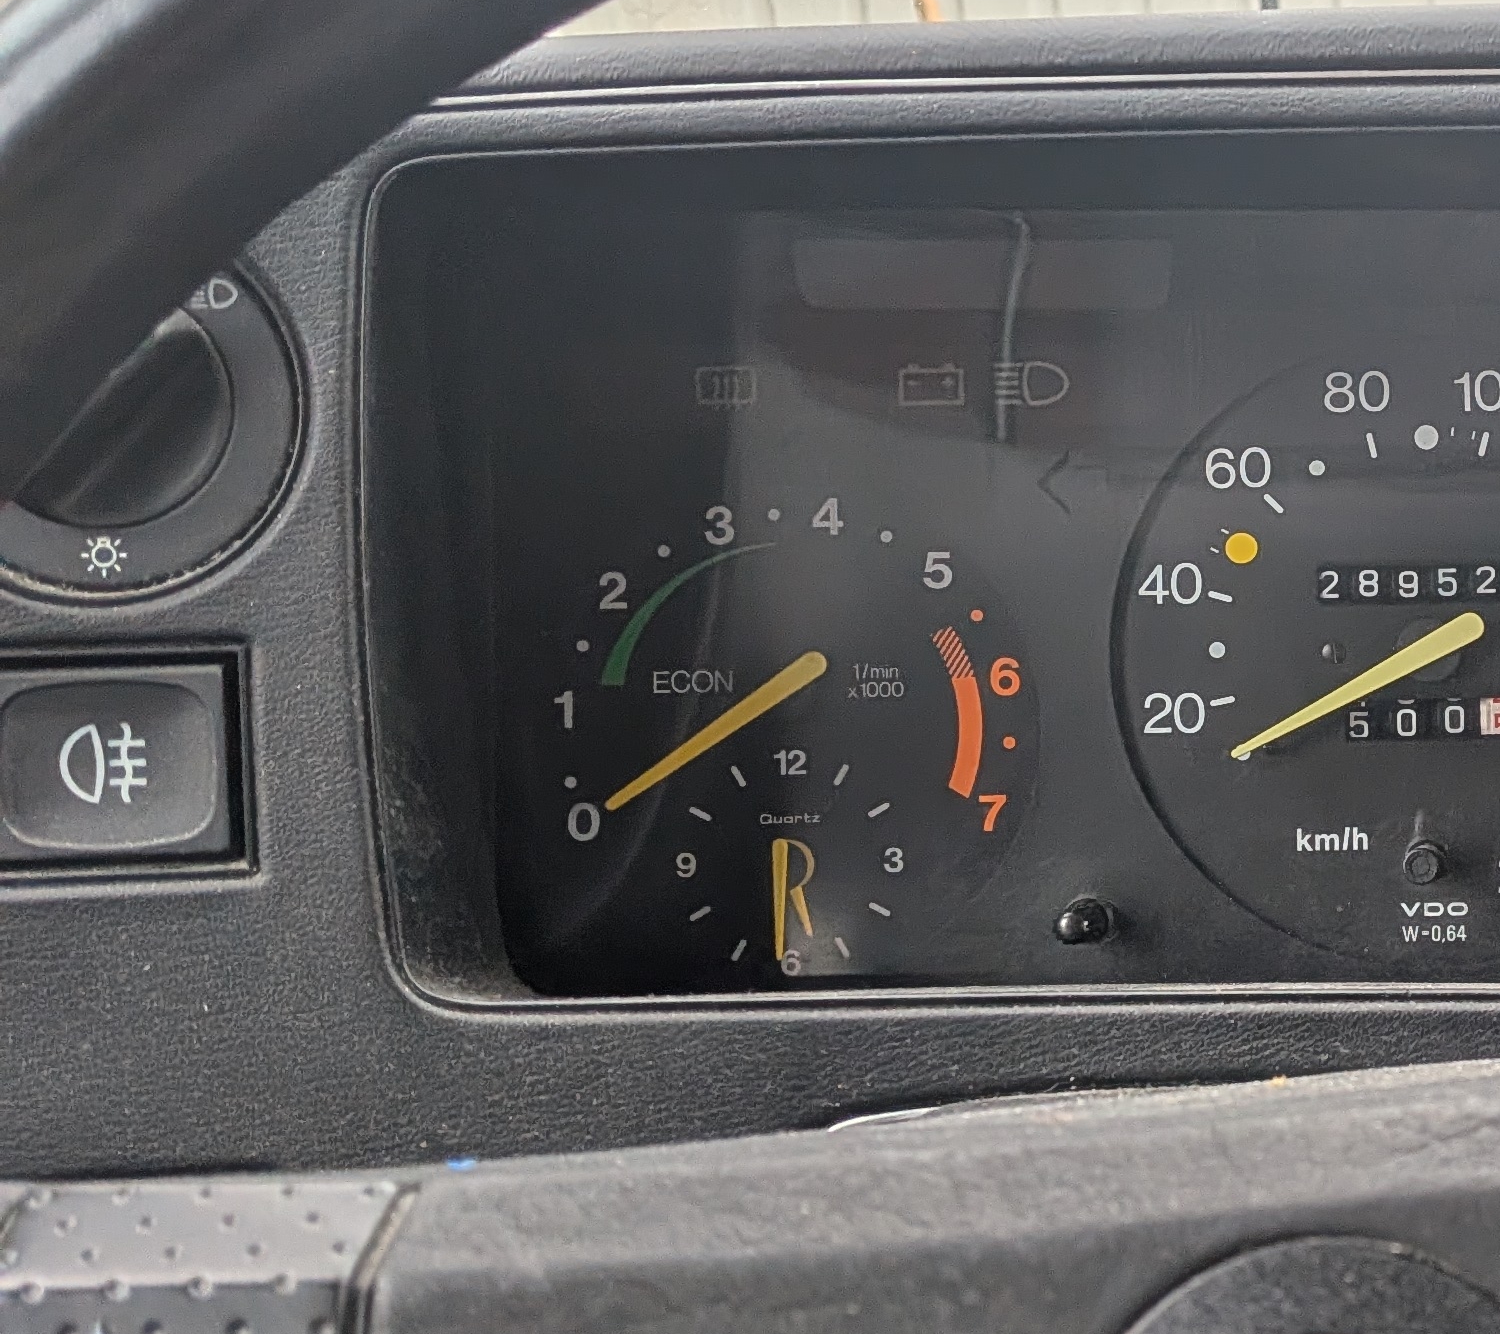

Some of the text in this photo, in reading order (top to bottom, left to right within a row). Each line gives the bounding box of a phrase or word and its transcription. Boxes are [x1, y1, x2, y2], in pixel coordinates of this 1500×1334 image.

[1323, 370, 1390, 413] 80
[1205, 446, 1271, 490] 60
[704, 505, 735, 546] 3
[812, 497, 844, 536] 4
[923, 551, 953, 590] 5
[1138, 562, 1203, 605] 40
[599, 571, 628, 610] 2
[652, 669, 733, 694] ECON
[989, 656, 1021, 697] 6
[553, 690, 574, 729] 1
[1143, 692, 1206, 734] 20
[773, 749, 808, 776] 12
[567, 802, 601, 842] 0
[759, 812, 821, 825] Quartz
[978, 794, 1007, 832] 7
[1296, 826, 1369, 852] km/h
[675, 852, 697, 878] 9
[883, 846, 904, 873] 3
[1400, 901, 1469, 918] VDO
[783, 948, 802, 976] 6
